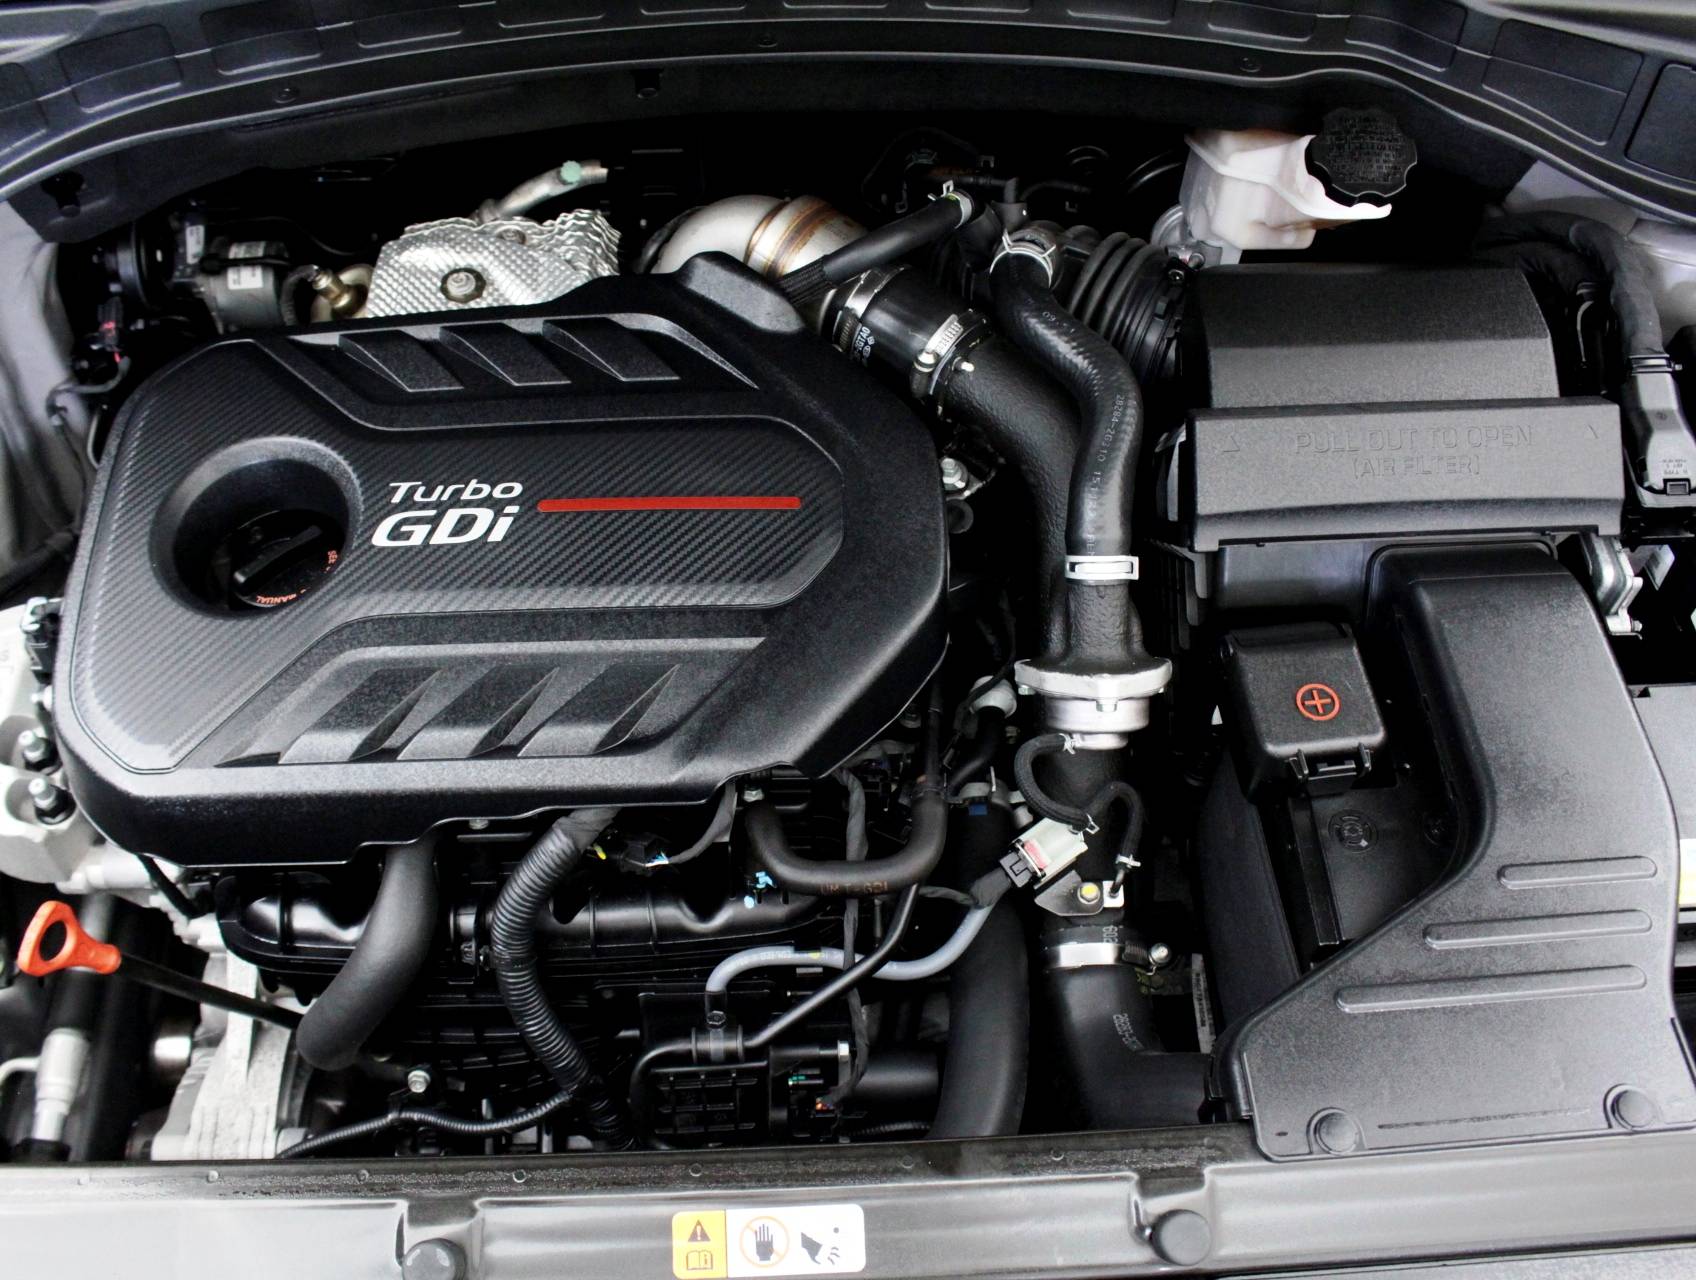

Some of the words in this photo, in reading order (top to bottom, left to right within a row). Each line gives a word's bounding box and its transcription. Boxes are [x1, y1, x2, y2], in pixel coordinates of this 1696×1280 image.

[1295, 427, 1360, 453] PULL
[1367, 425, 1418, 450] OUT
[1429, 424, 1459, 449] TO
[1466, 423, 1533, 448] OPEN
[388, 478, 524, 505] Turbo
[371, 505, 523, 547] GDi
